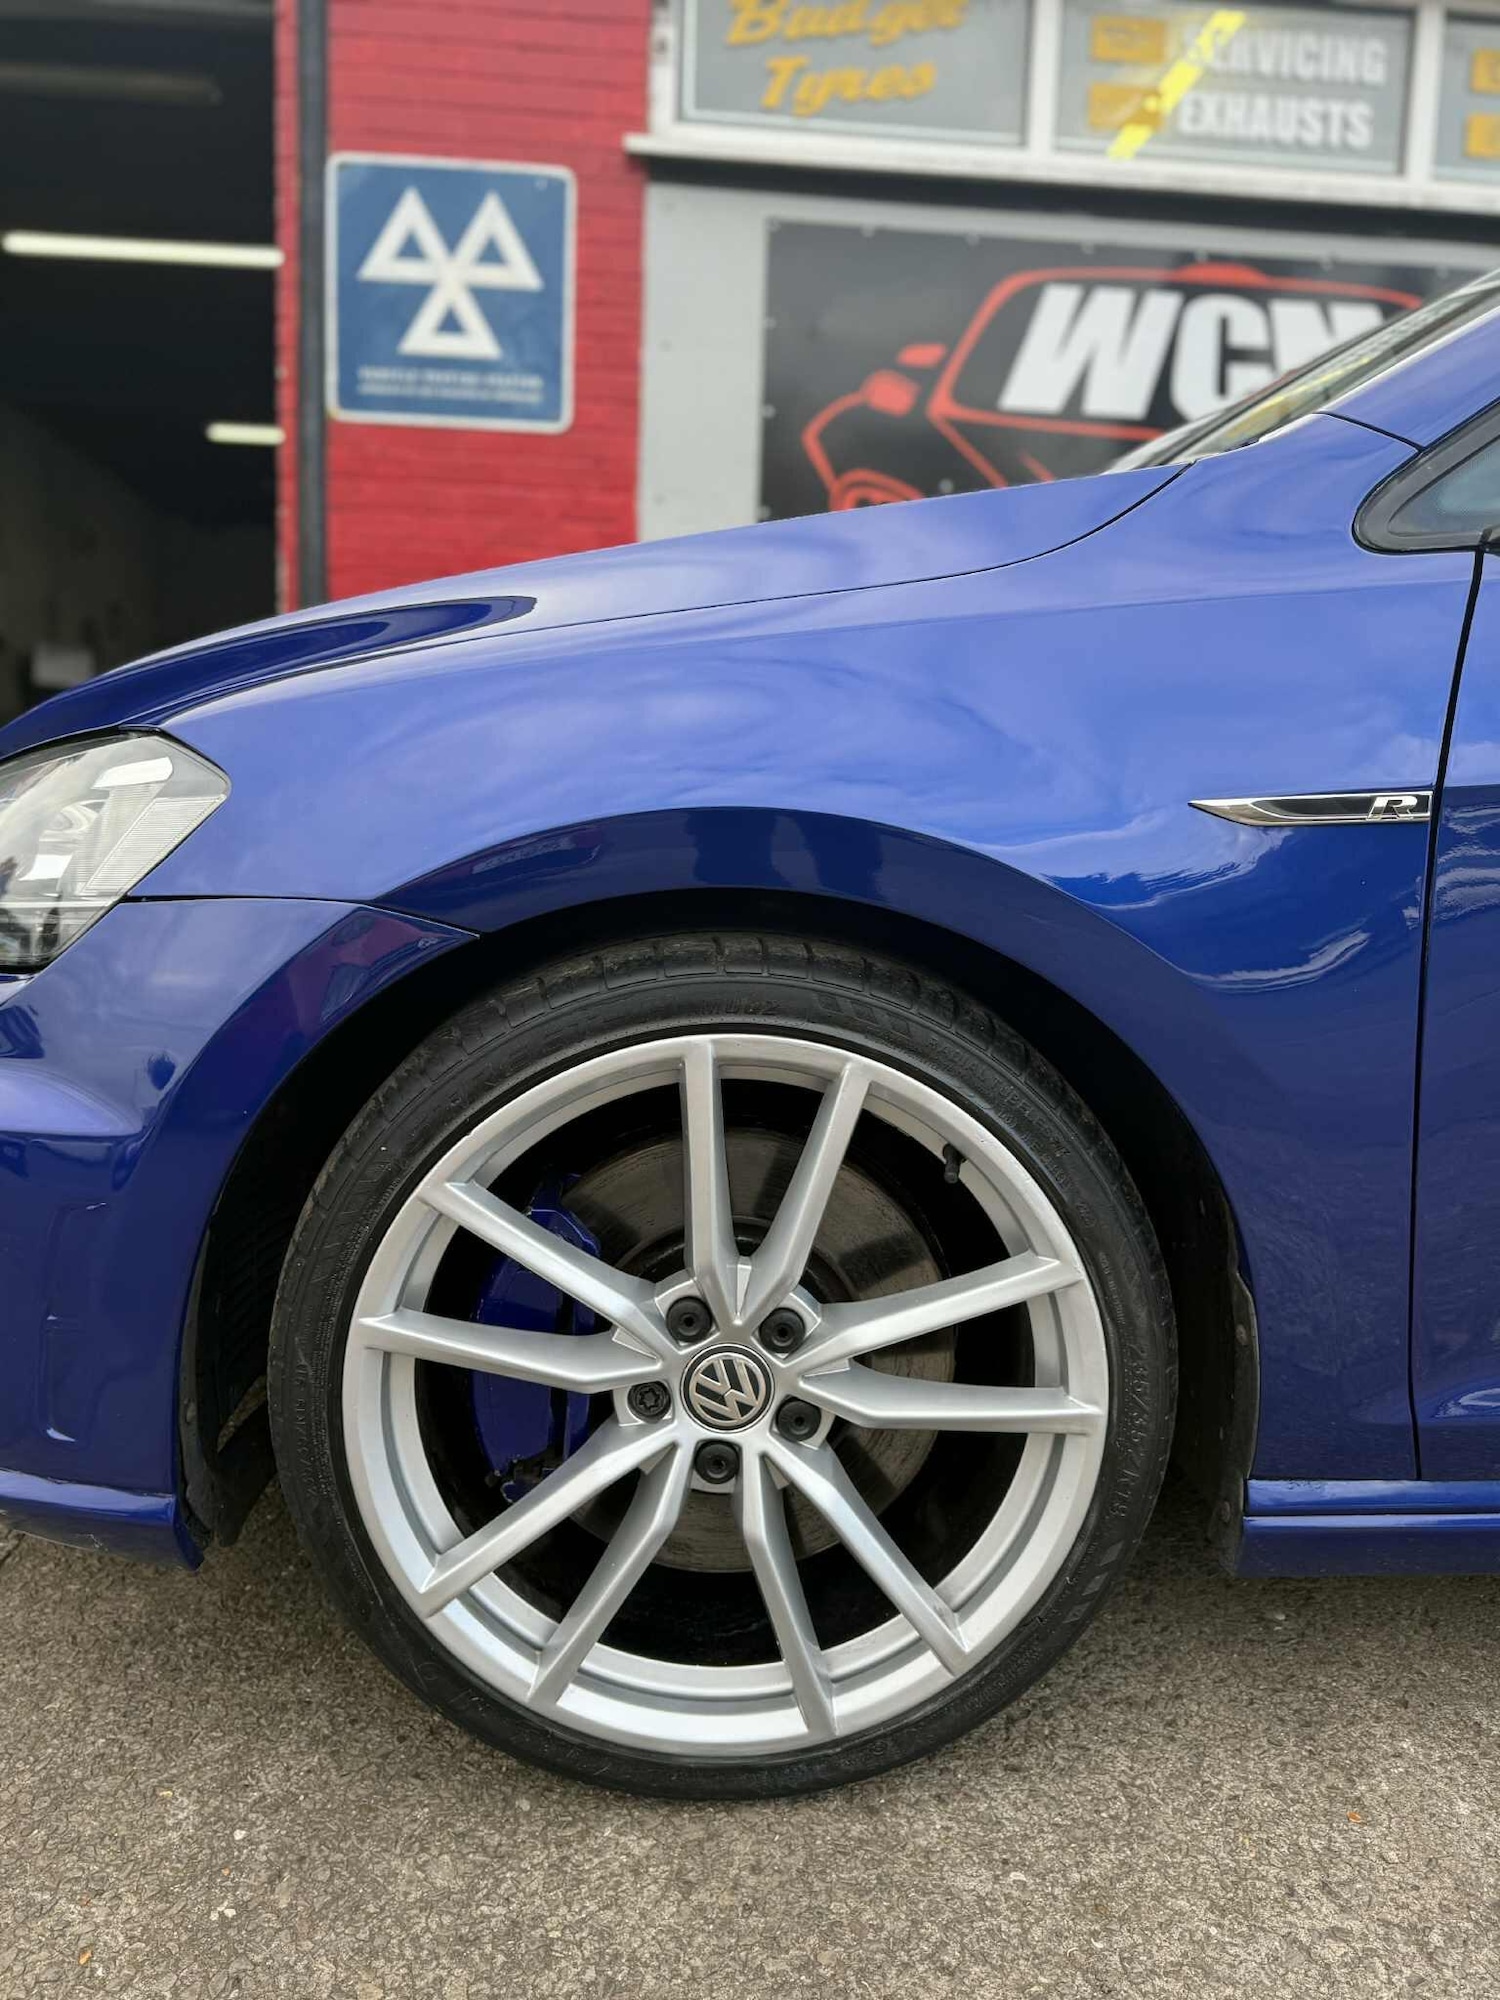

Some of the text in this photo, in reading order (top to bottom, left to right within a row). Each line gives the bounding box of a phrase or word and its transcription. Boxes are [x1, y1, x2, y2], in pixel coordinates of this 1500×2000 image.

[760, 56, 937, 117] Tyres
[1178, 92, 1374, 149] EXHAUSTS
[1366, 795, 1418, 821] R
[690, 1352, 766, 1426] VW
